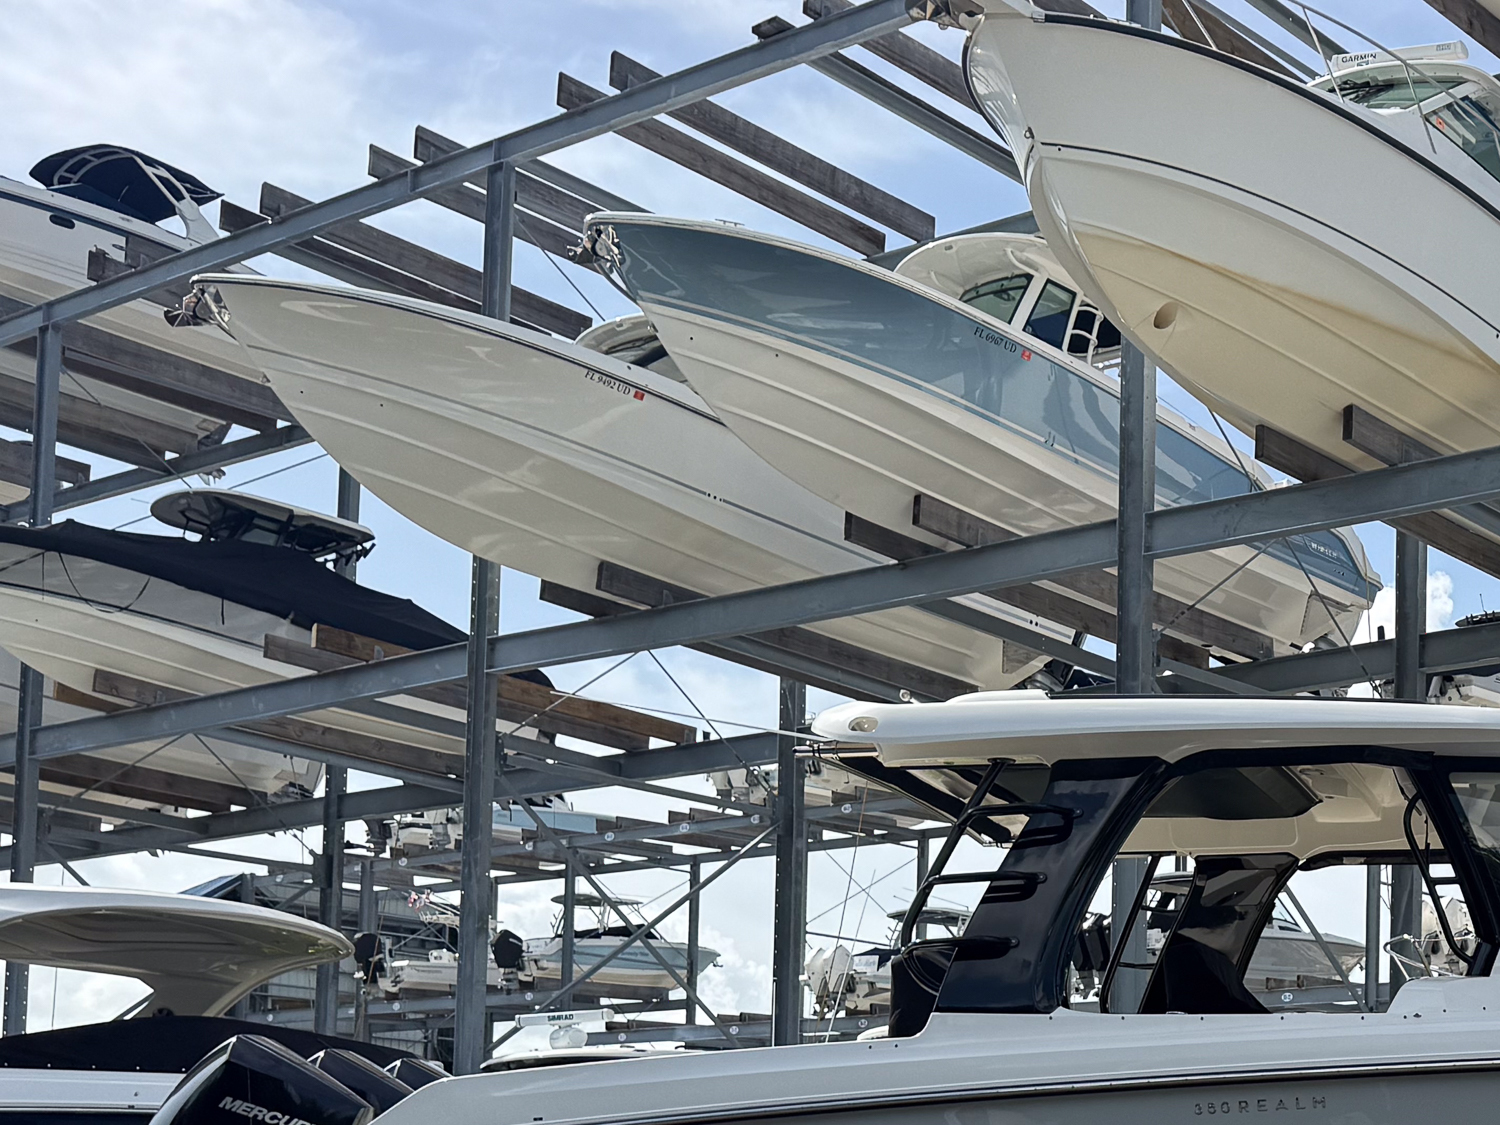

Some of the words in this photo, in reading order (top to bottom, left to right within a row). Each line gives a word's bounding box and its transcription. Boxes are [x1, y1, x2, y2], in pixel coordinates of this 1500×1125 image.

[1341, 53, 1377, 63] GARMIN
[974, 326, 984, 339] FL
[985, 332, 1004, 347] 6967
[1003, 340, 1017, 353] UD
[584, 370, 596, 381] FL
[597, 375, 616, 390] 9492
[616, 383, 631, 396] UD
[547, 1013, 574, 1022] SIMRAD
[1238, 1096, 1327, 1113] REALM
